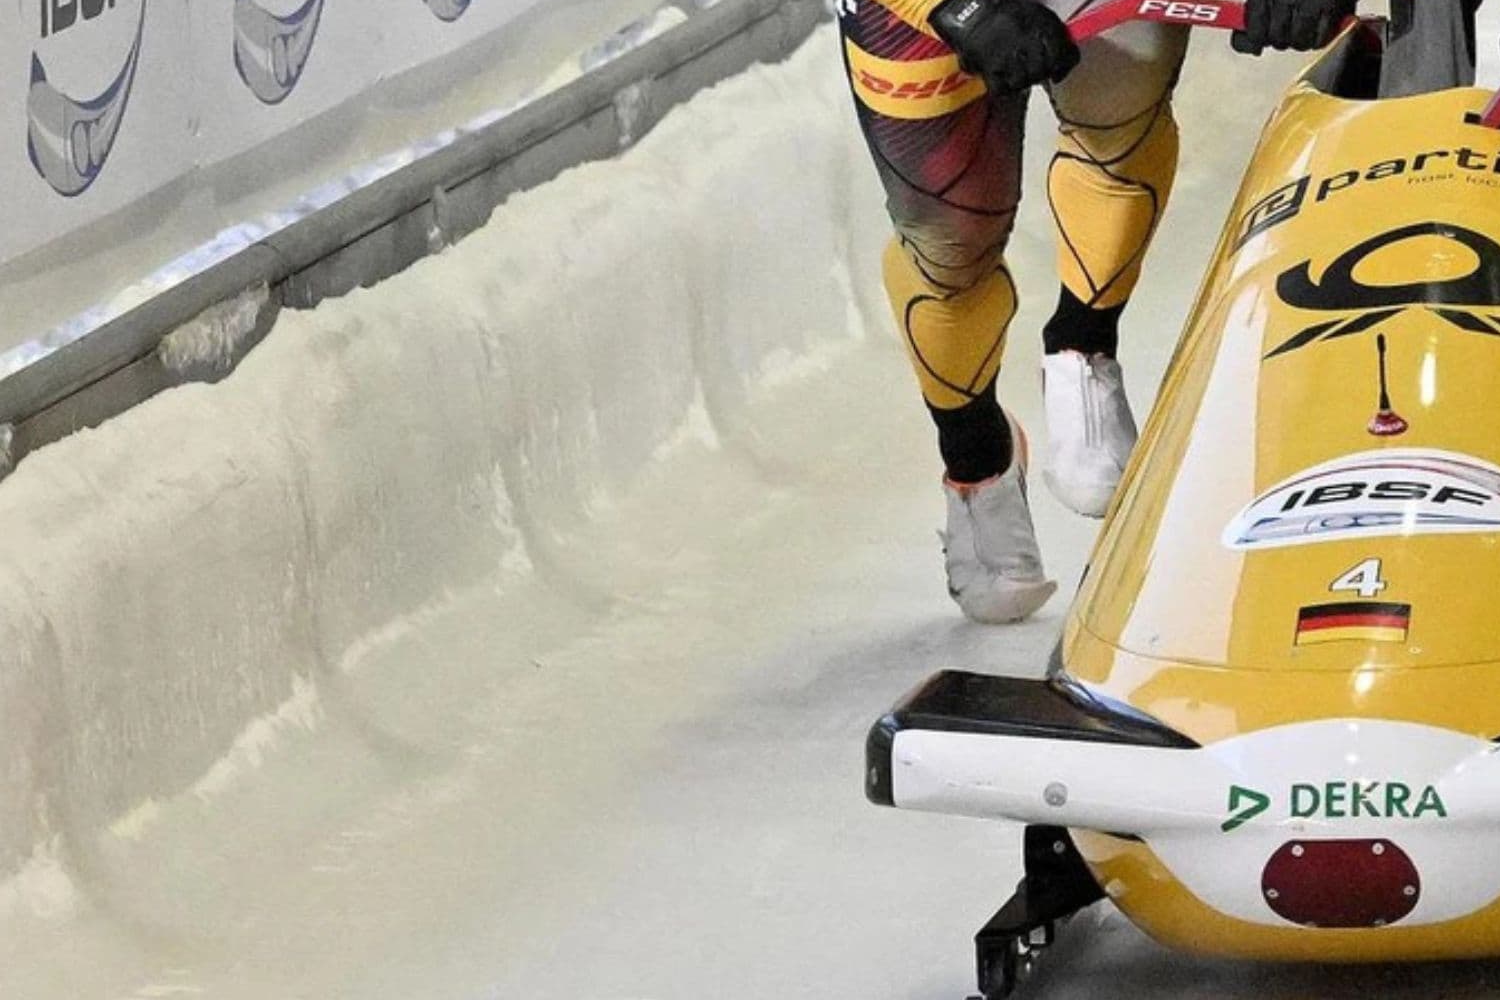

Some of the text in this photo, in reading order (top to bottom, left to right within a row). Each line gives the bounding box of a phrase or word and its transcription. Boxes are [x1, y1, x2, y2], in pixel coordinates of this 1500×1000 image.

[860, 69, 970, 99] DHL
[1280, 481, 1493, 513] IBSF
[1327, 557, 1389, 598] 4
[1290, 781, 1449, 820] DEKRA
